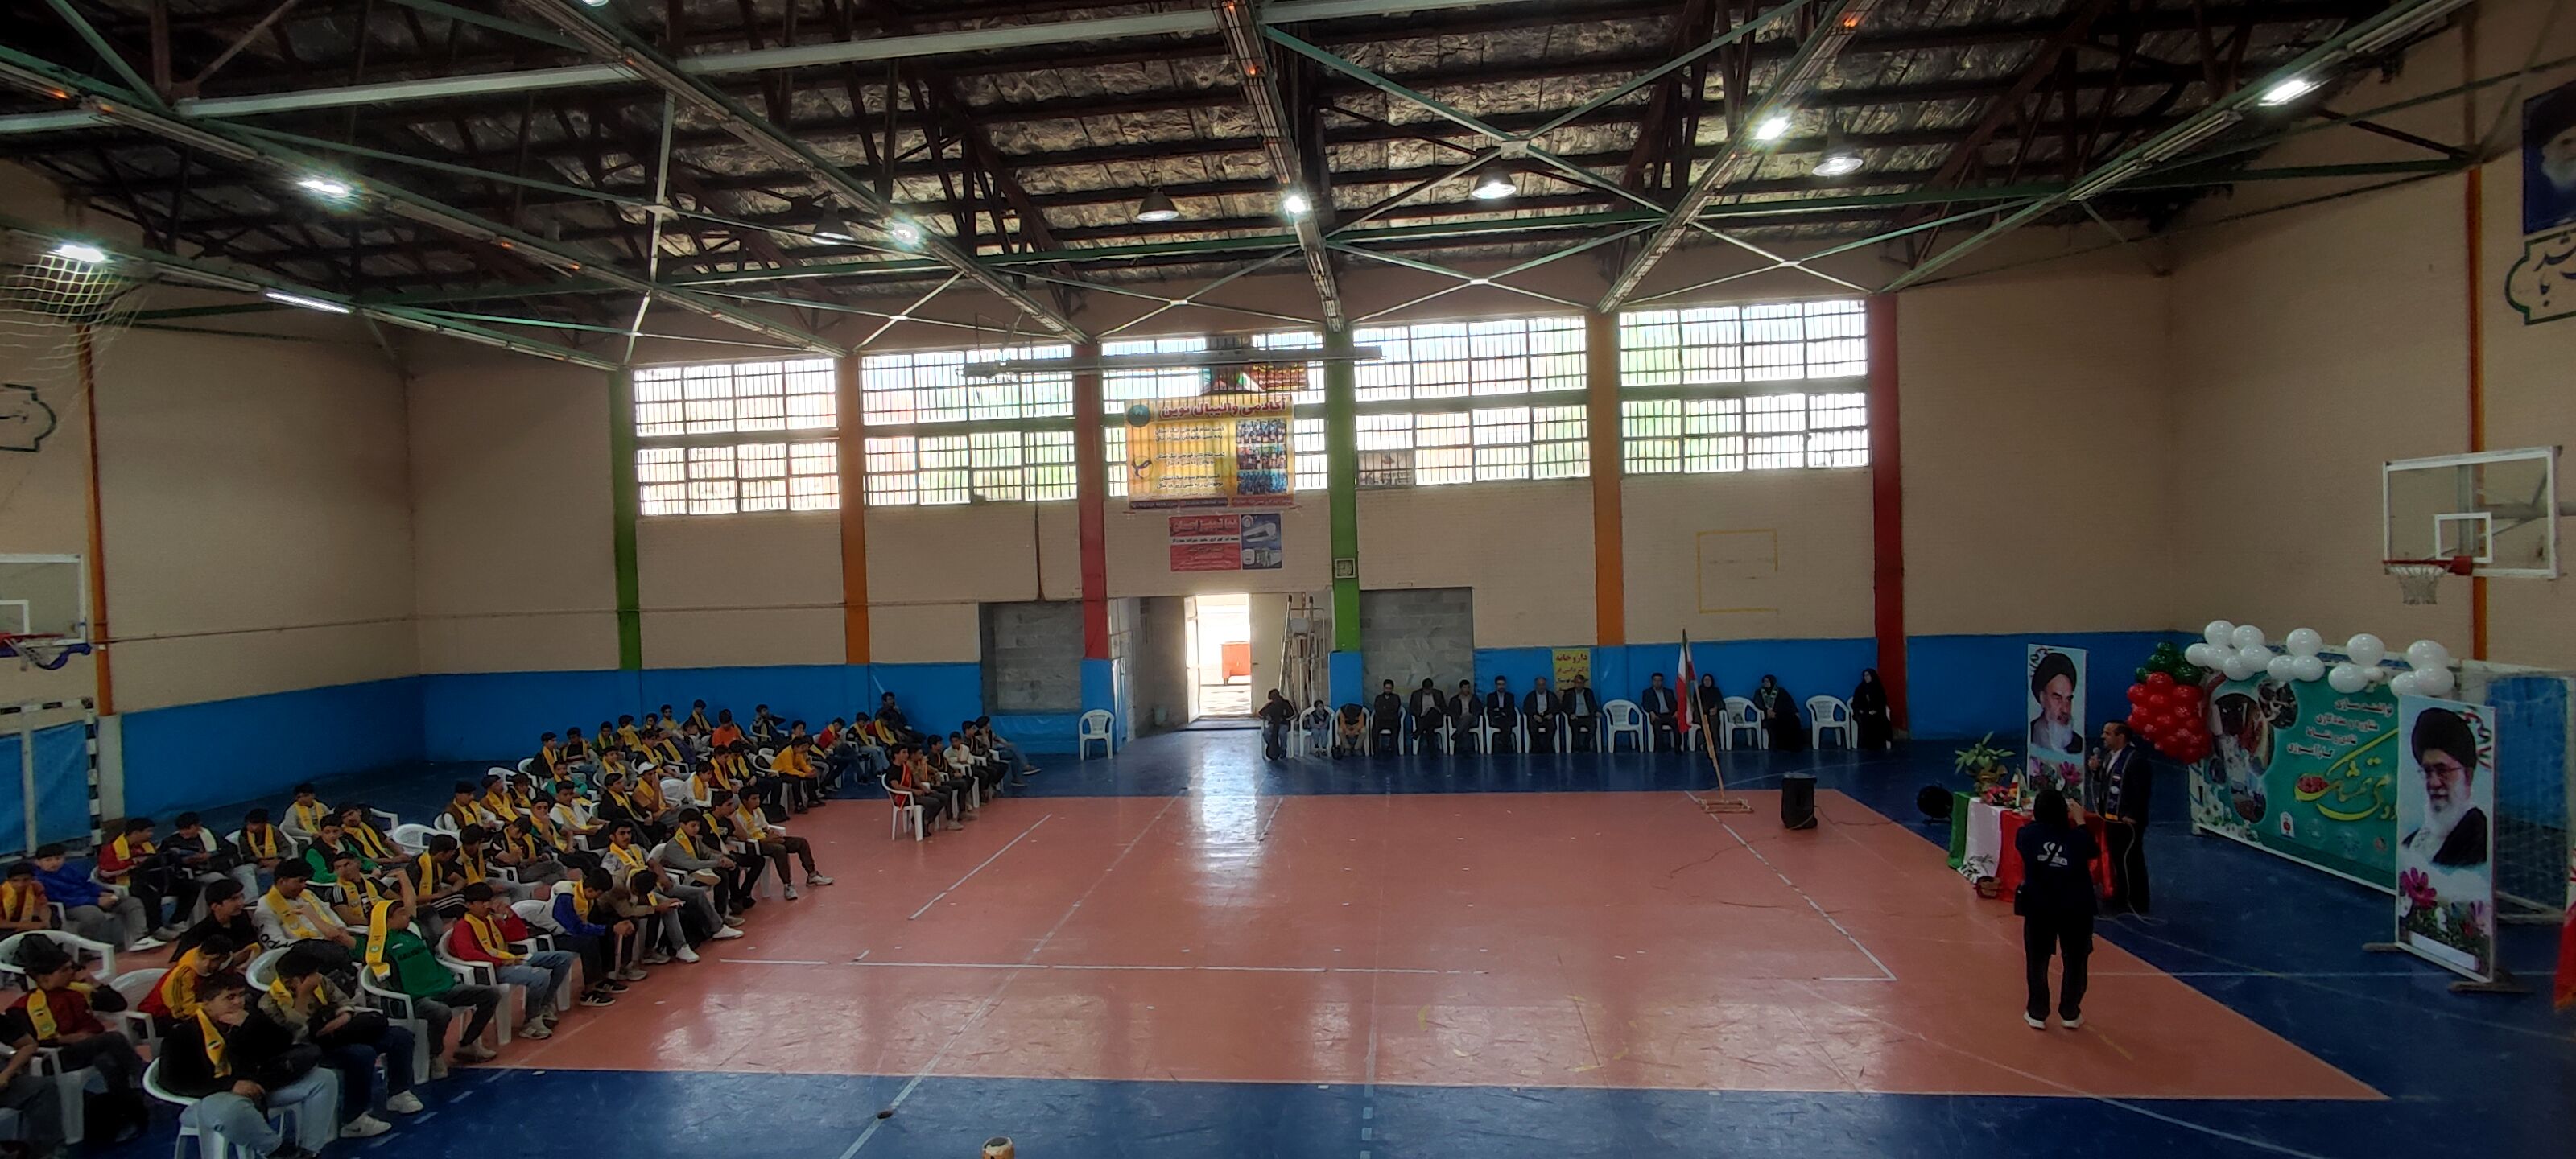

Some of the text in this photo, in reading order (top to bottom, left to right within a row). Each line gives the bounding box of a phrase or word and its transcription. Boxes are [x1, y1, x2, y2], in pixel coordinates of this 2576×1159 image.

[1161, 406, 1190, 419] نوین
[1194, 402, 1238, 416] والیبال
[1241, 399, 1286, 418] آکادمی
